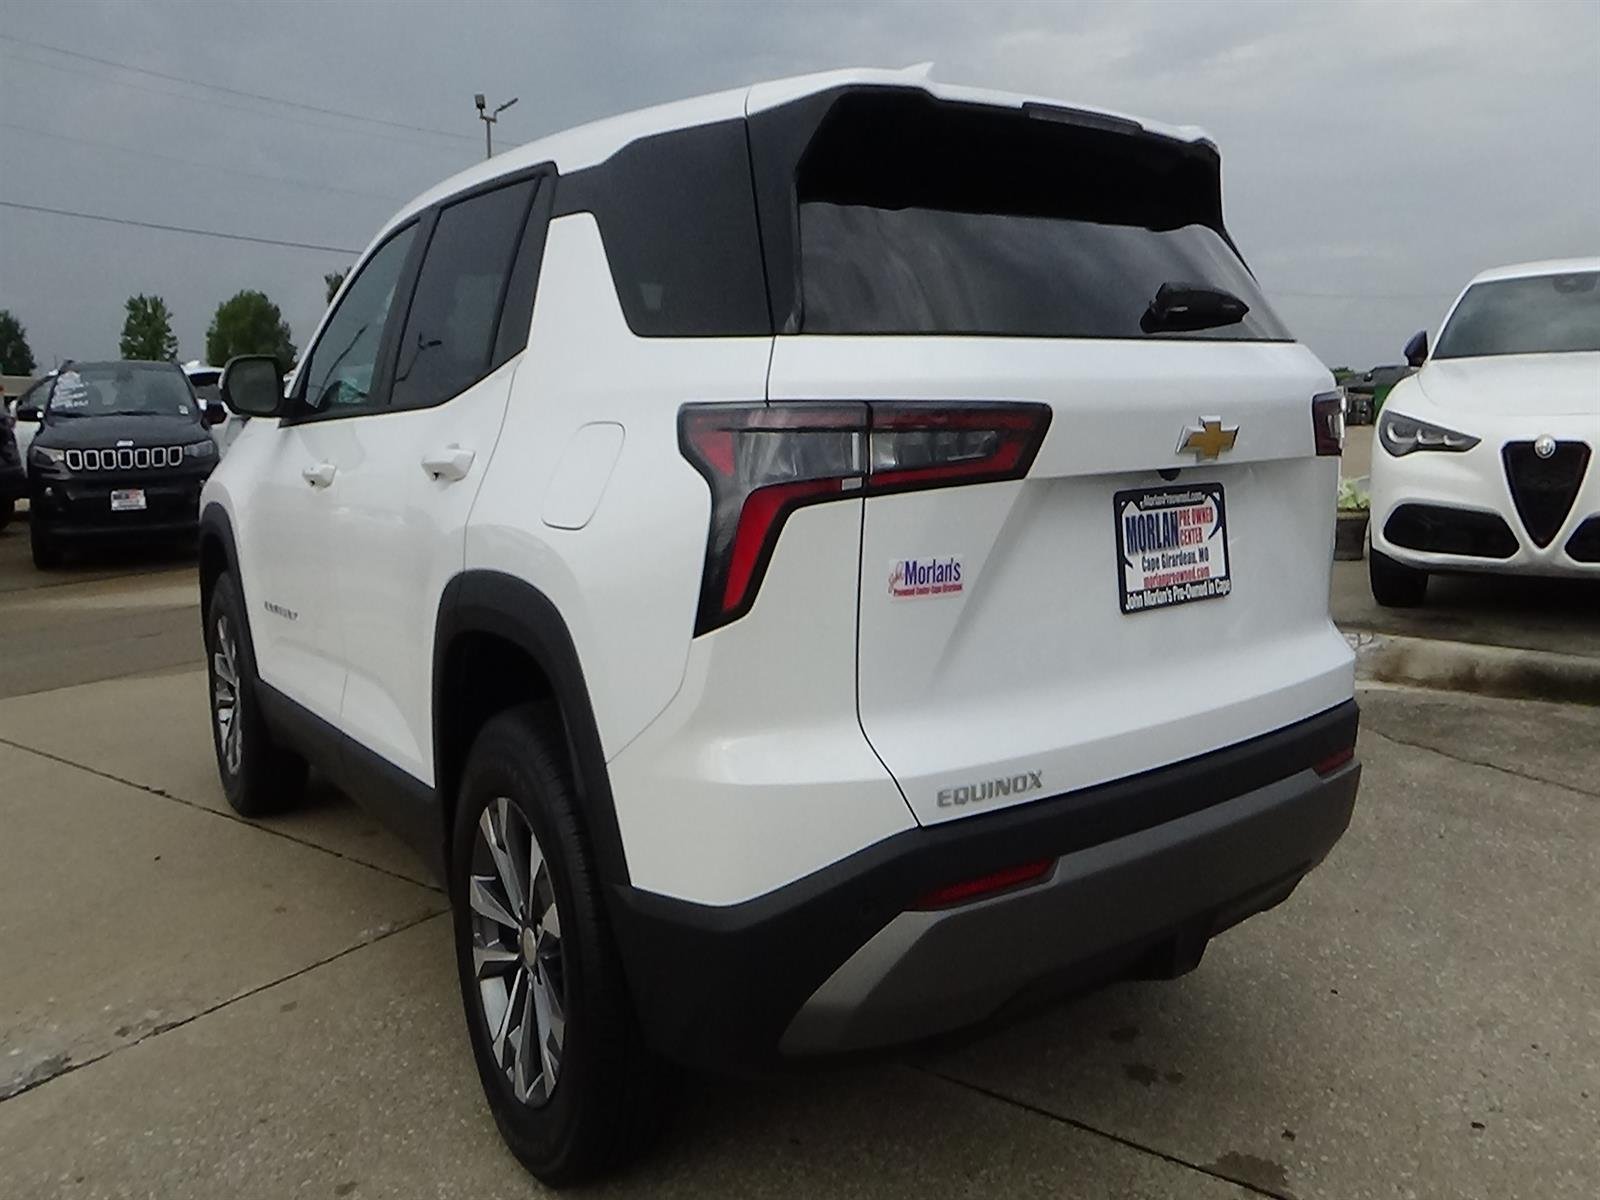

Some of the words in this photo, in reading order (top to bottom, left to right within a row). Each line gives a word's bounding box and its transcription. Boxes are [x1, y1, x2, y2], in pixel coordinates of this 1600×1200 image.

[1179, 509, 1191, 527] PRE
[1192, 507, 1214, 525] OWNED
[1125, 510, 1180, 555] MORLAN
[1180, 526, 1204, 545] CENTER
[905, 557, 961, 586] Morlan's
[1142, 555, 1160, 572] Cape
[1198, 546, 1209, 563] MO
[1126, 591, 1143, 610] John
[1143, 587, 1173, 606] Morlan's
[1215, 578, 1231, 595] Cape
[937, 769, 1043, 808] EQUINOX
